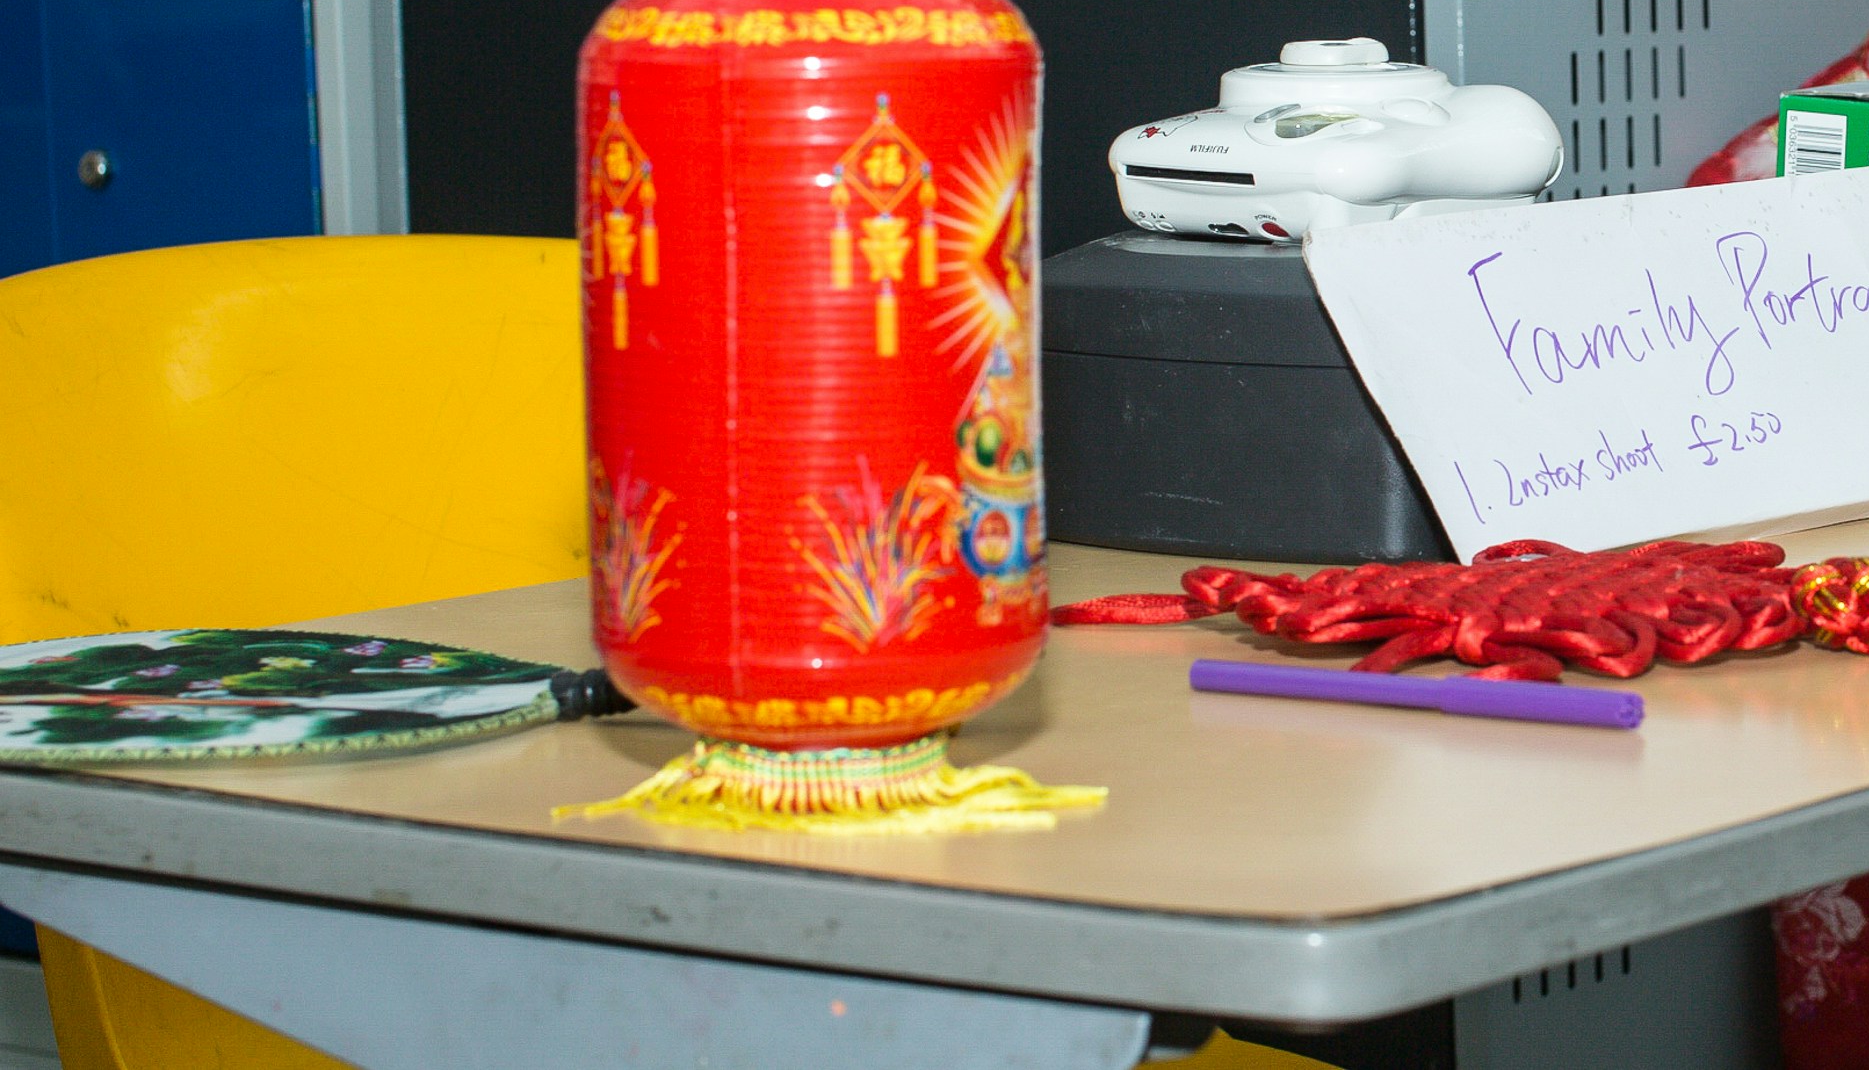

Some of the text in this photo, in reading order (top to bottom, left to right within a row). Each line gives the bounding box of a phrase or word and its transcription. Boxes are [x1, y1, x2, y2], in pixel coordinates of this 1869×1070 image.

[1190, 144, 1229, 154] FUJIFILM
[1468, 251, 1739, 396] Family
[1597, 430, 1663, 481] shoot
[1688, 412, 1782, 466] £2.50
